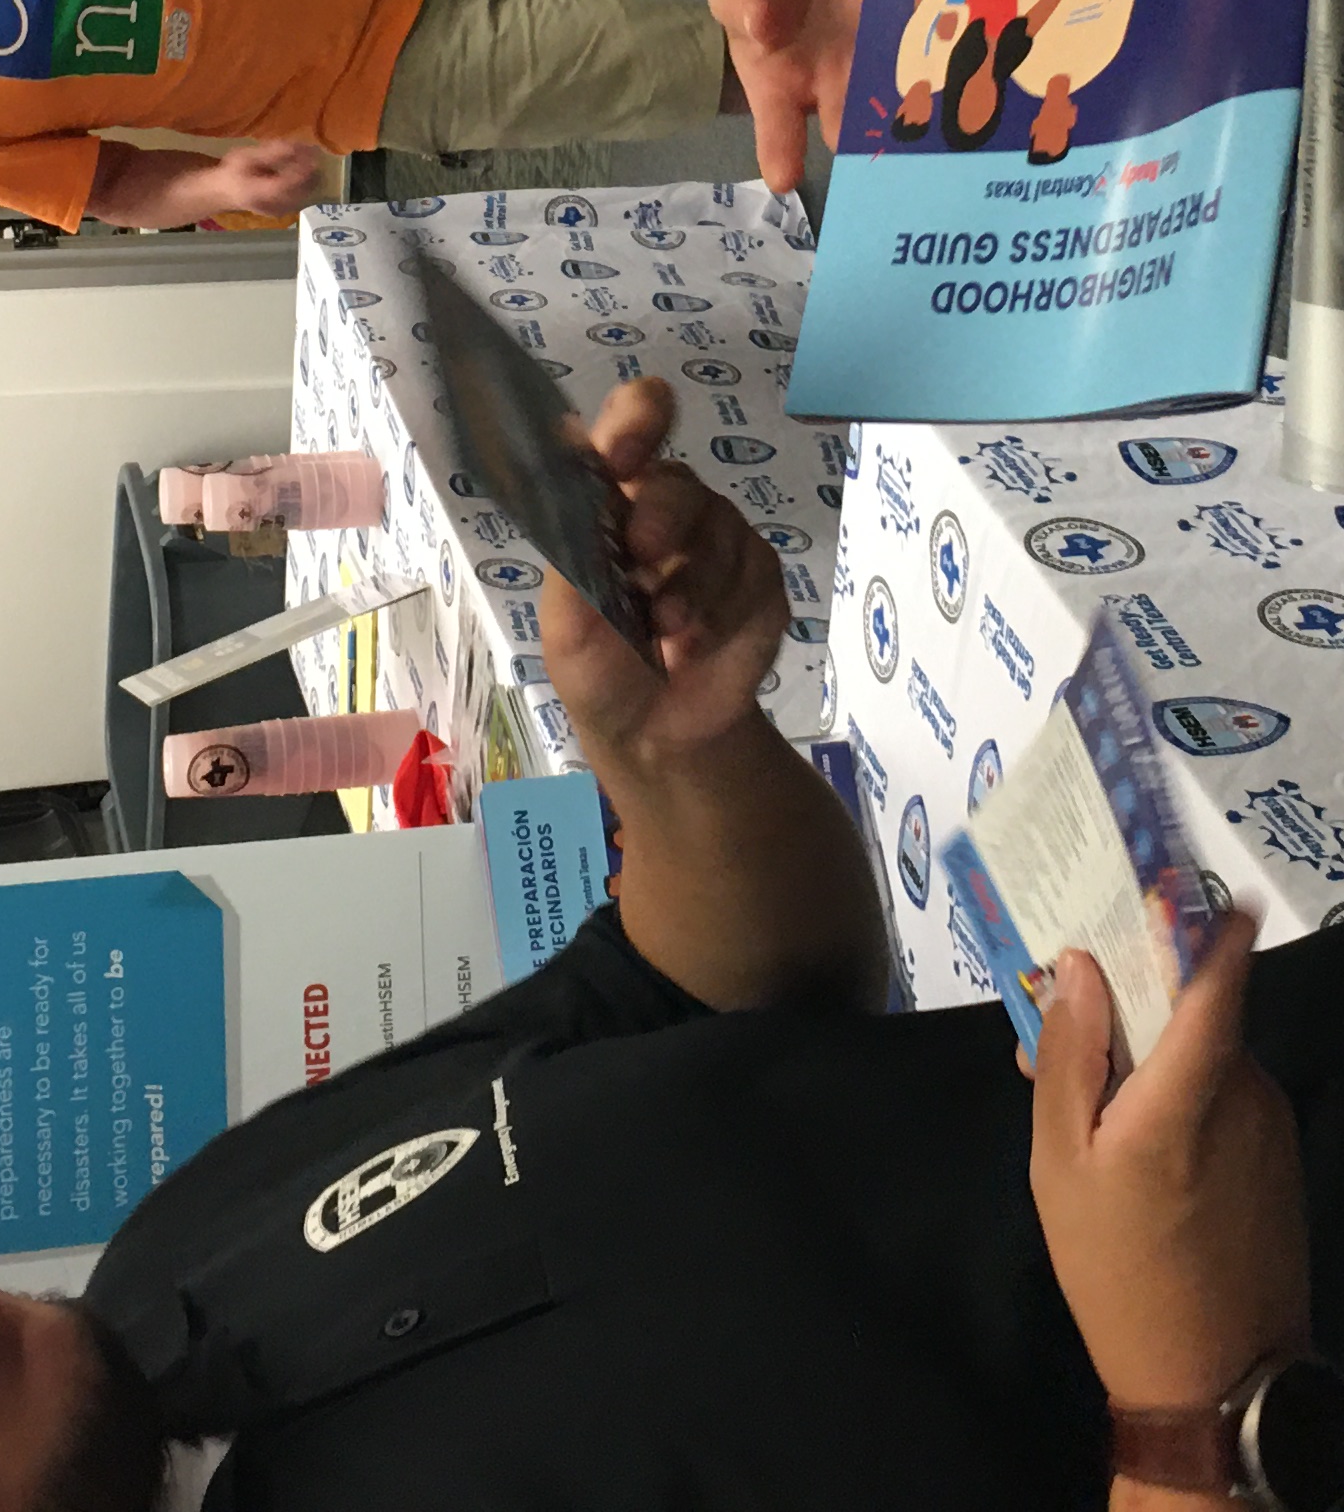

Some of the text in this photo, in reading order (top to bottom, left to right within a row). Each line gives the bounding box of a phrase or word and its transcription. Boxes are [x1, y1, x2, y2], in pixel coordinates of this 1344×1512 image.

[982, 179, 1032, 203] Texas
[1032, 173, 1095, 203] Central
[889, 185, 1223, 265] PREPAREDNESS GUIDE
[929, 250, 1177, 314] NEIGHBORHOOD
[1133, 441, 1172, 478] HSEM
[983, 593, 1035, 678] Central Texas
[1130, 593, 1170, 626] Texas
[990, 626, 1032, 701] Get Ready
[1117, 610, 1175, 670] Get Ready
[1156, 625, 1202, 668] Central
[1169, 705, 1217, 748] HSEM
[511, 809, 546, 951] PREPARACIÓN
[577, 846, 590, 874] Texas
[67, 960, 87, 983] of
[71, 930, 88, 955] us
[68, 991, 87, 1015] all
[376, 963, 395, 1051] ustinHSEM
[69, 1021, 89, 1081] takes
[302, 983, 331, 1086] NECTED
[30, 936, 56, 1216] necessary to be ready for
[70, 1087, 88, 1101] It
[104, 949, 132, 1208] working together to be
[144, 1083, 170, 1185] repared!
